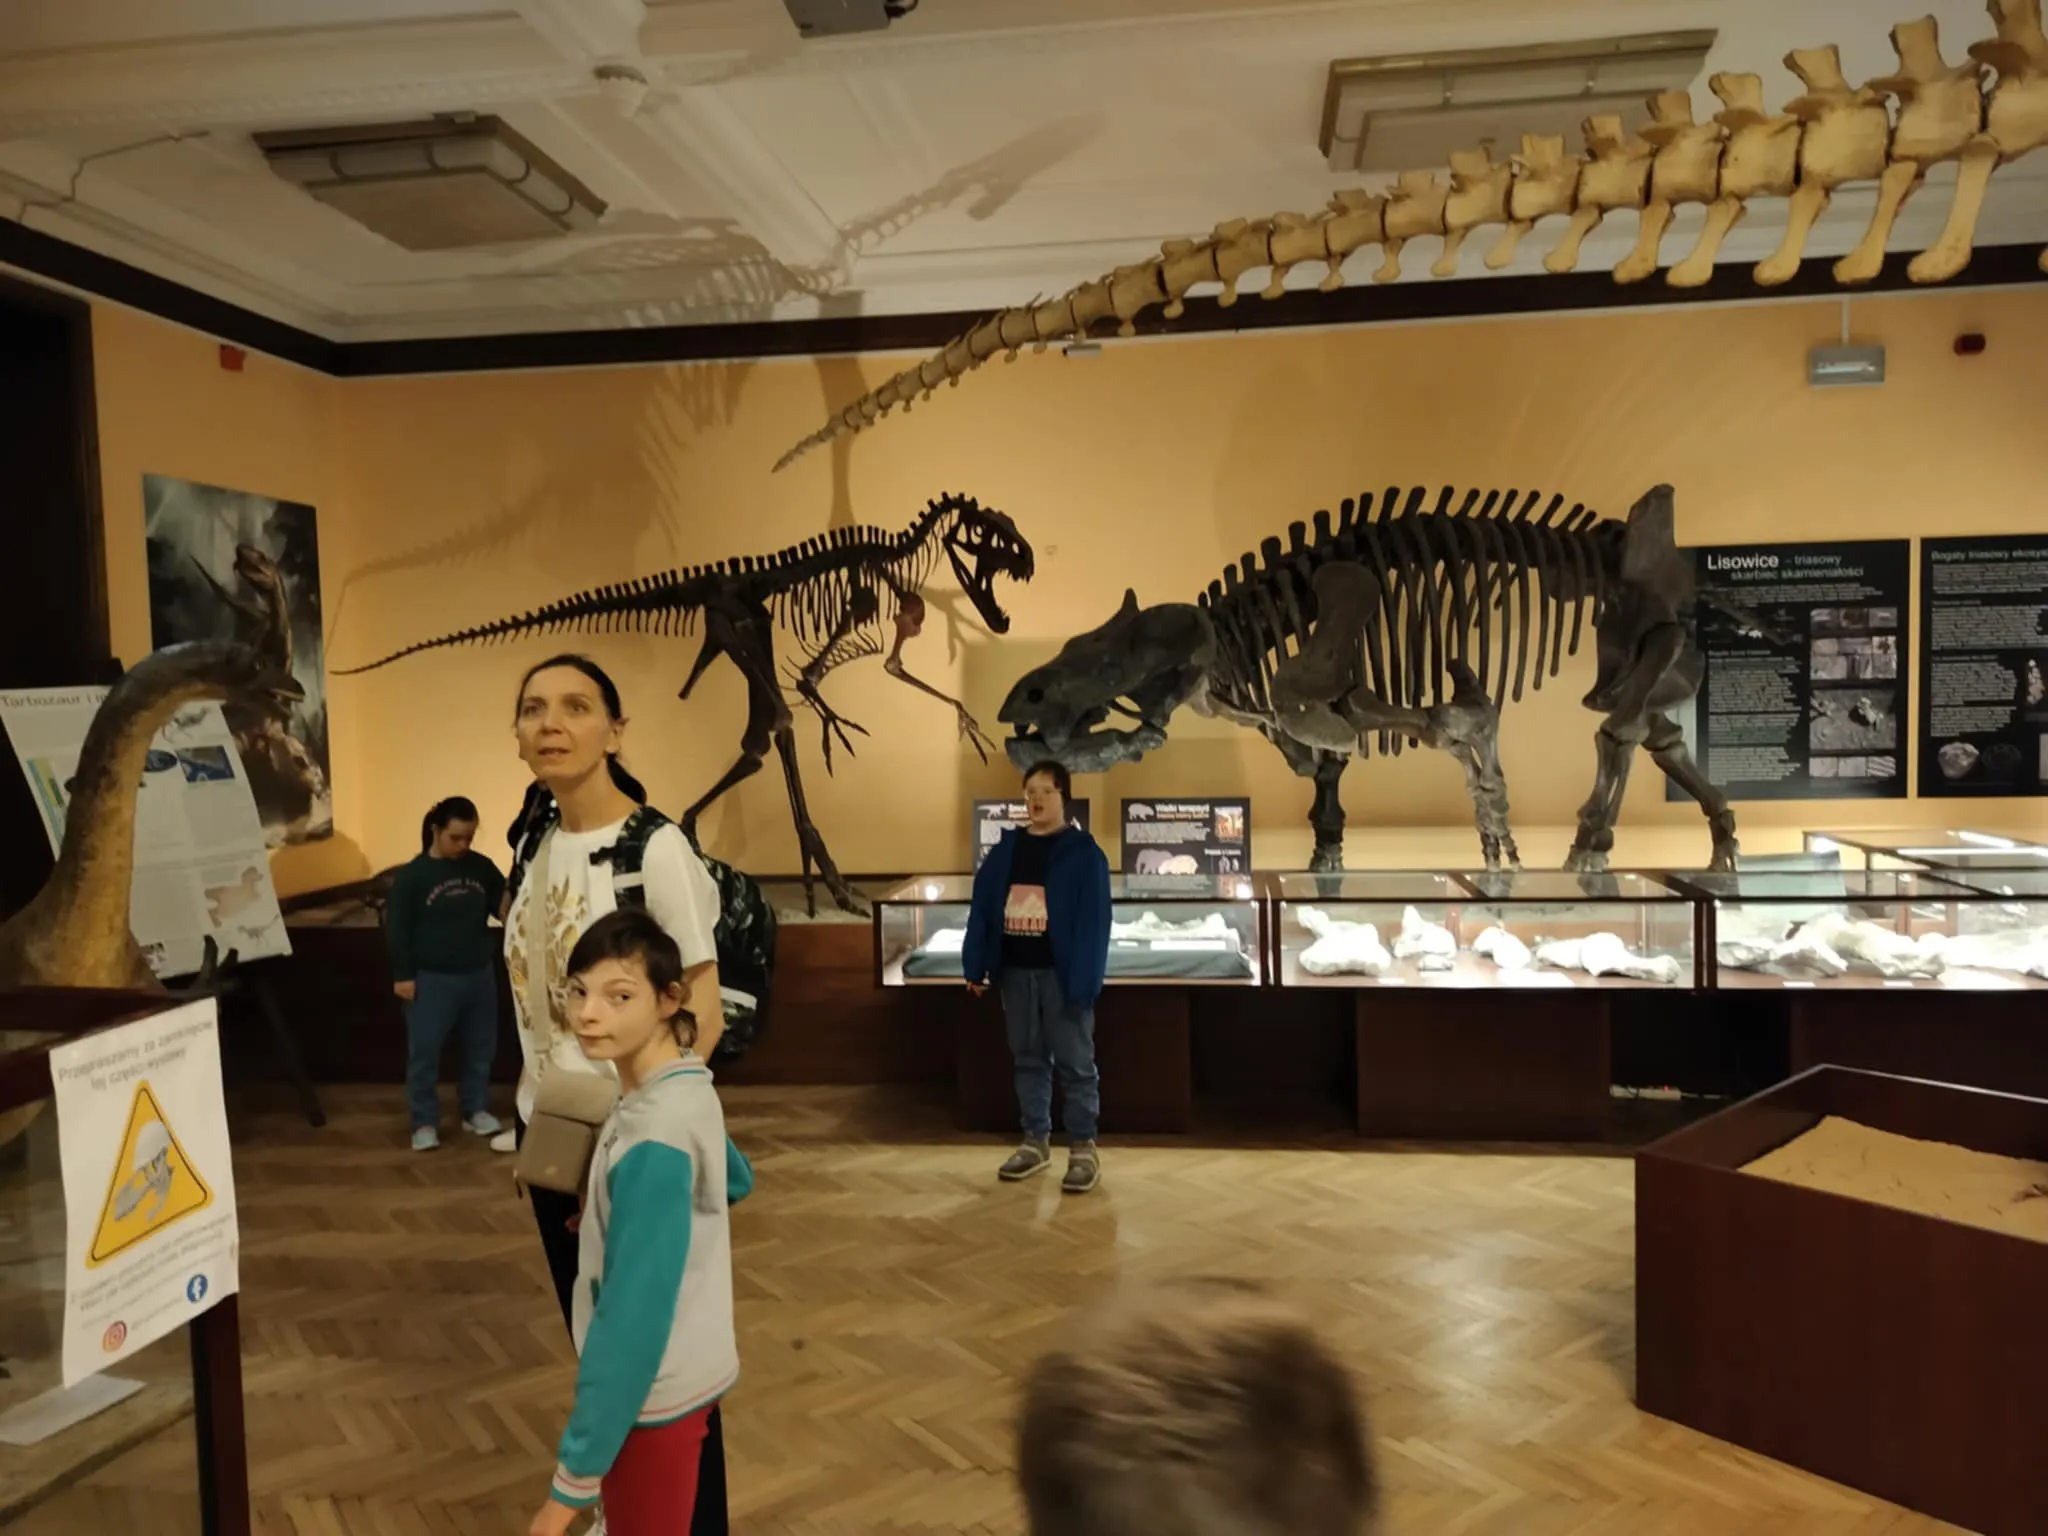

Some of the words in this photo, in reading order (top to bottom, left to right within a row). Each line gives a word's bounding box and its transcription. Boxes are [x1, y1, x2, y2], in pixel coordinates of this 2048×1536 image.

[1707, 552, 1779, 570] Lisowice
[1794, 554, 1842, 567] triasowy
[1731, 569, 1778, 580] skarbiec
[1781, 566, 1864, 579] skamieniałości
[58, 1047, 139, 1082] Przepraszamy
